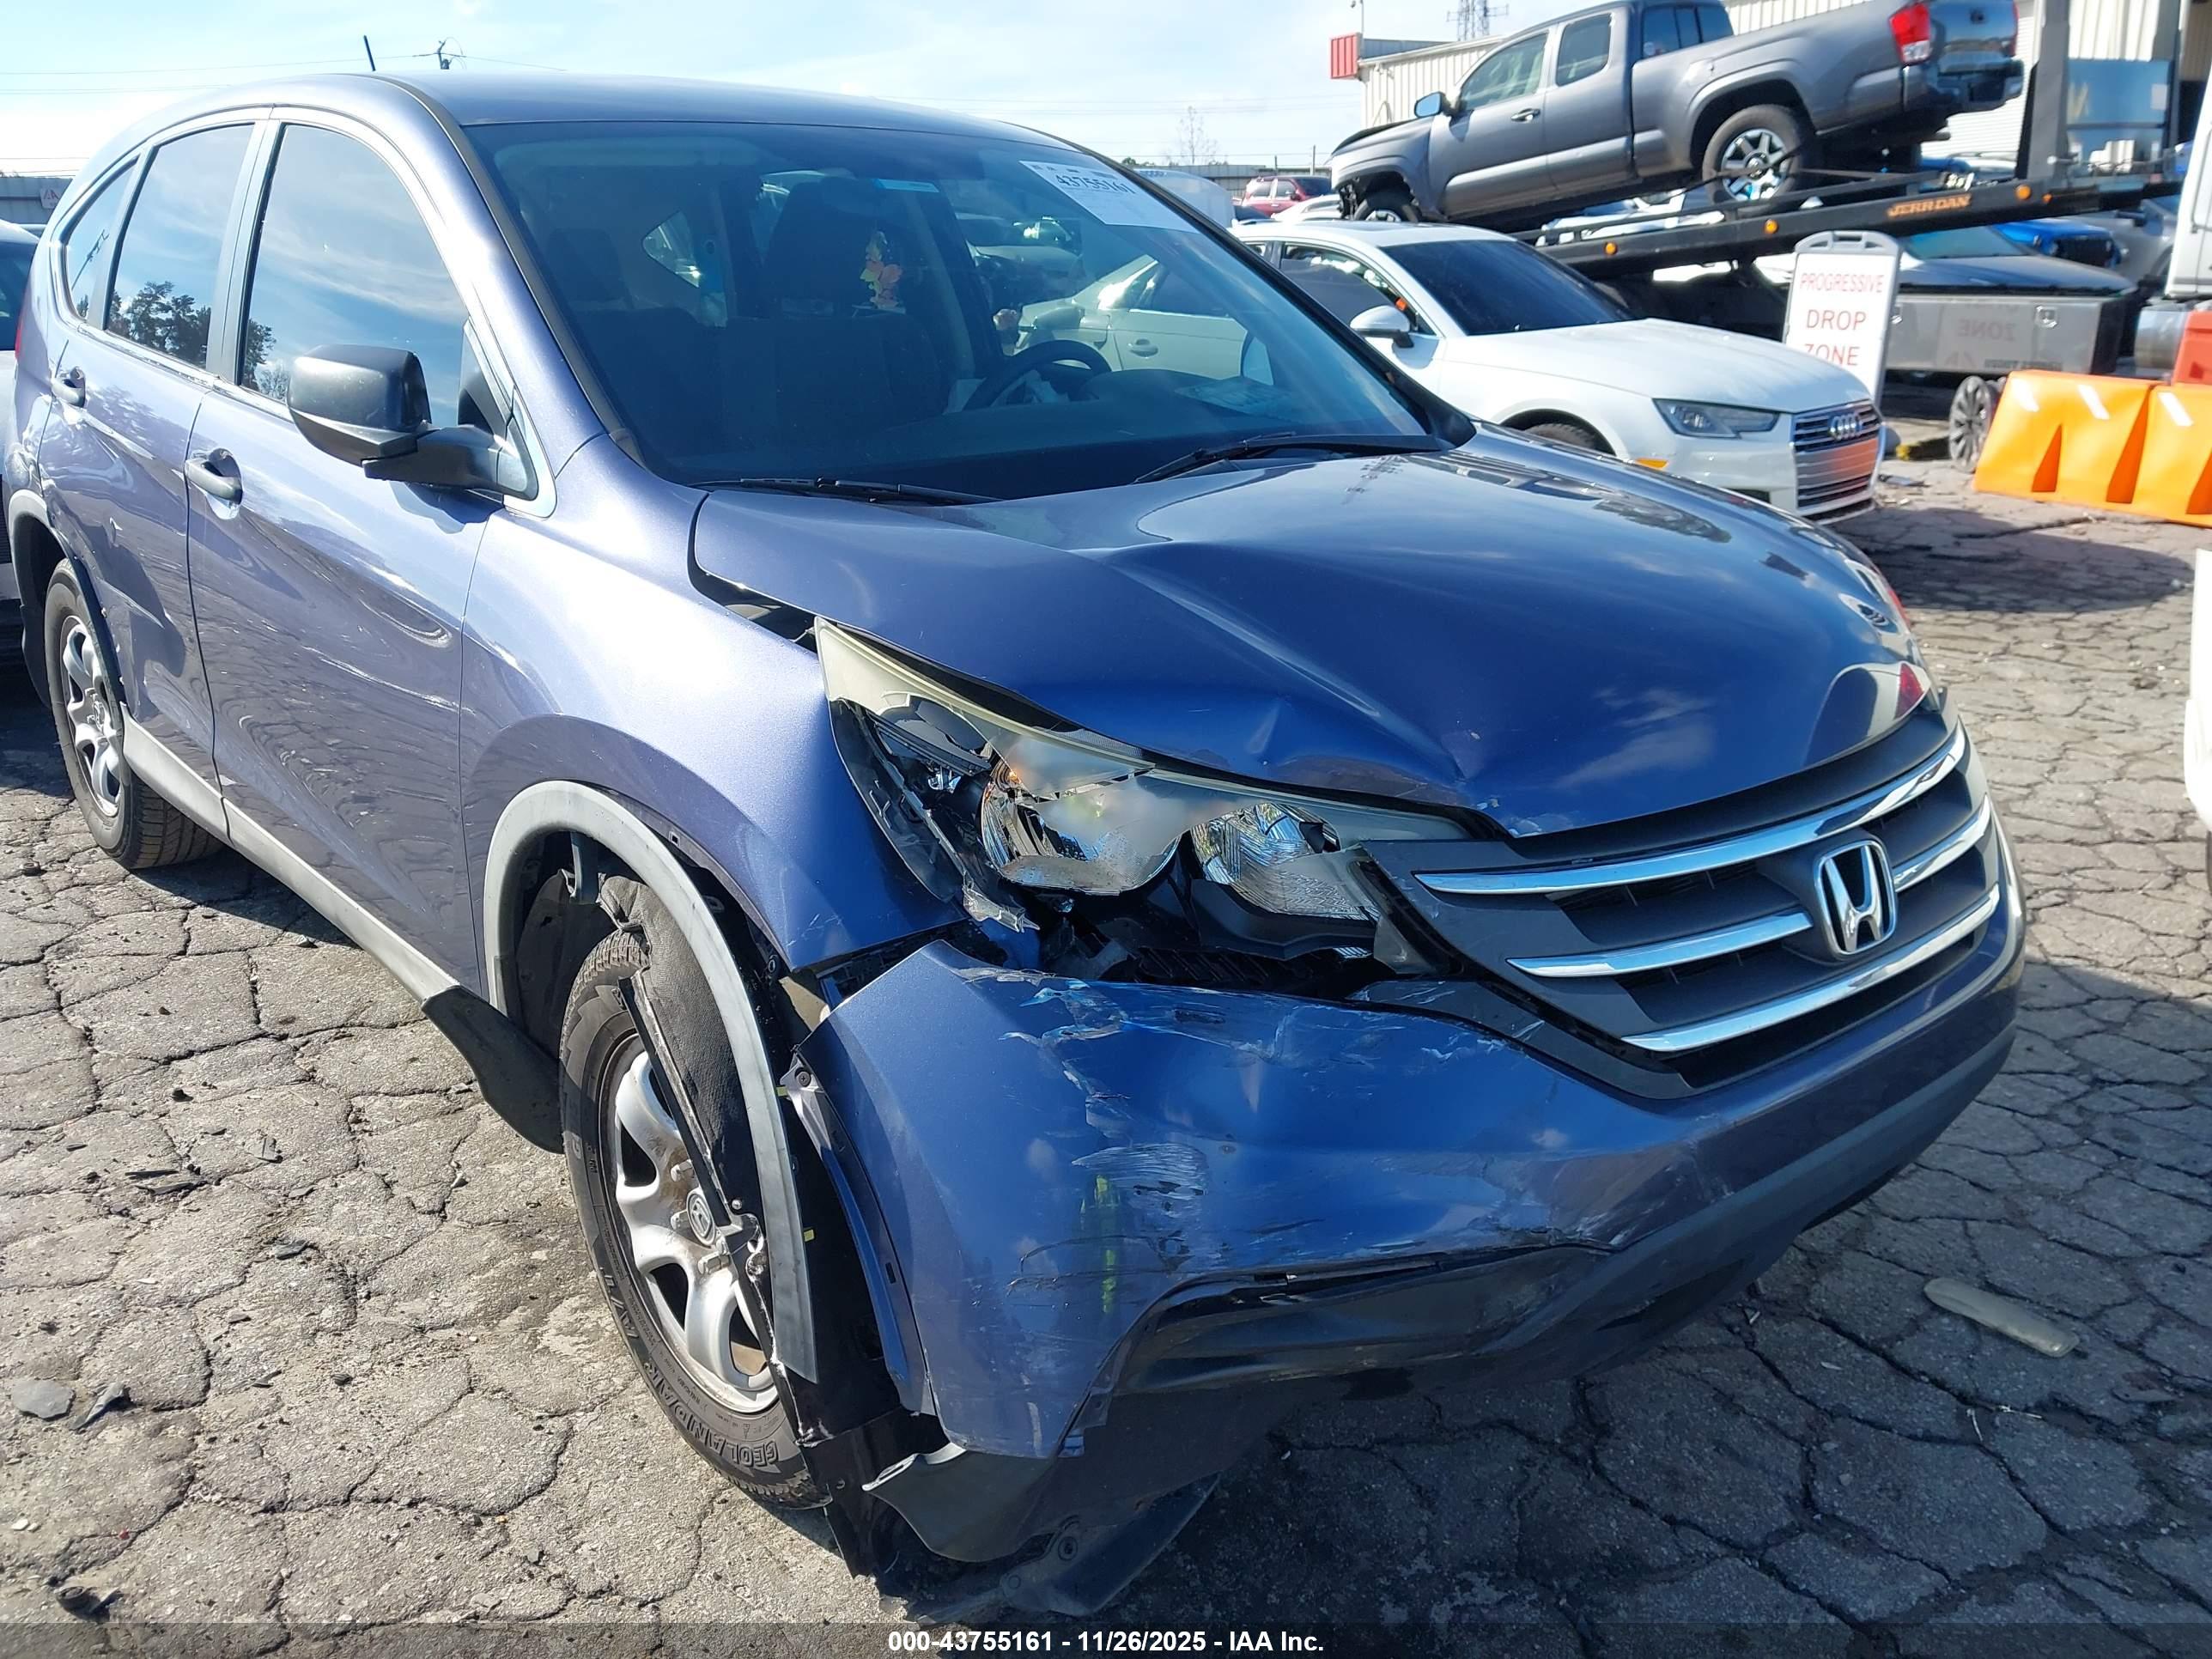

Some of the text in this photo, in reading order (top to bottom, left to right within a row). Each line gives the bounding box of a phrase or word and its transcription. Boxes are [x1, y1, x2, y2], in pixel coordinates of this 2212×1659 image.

[1054, 174, 1137, 194] 43755161
[1799, 272, 1885, 294] PROGRESSIVE
[1806, 309, 1867, 331] DROP
[644, 1361, 779, 1468] GEOLANDAR
